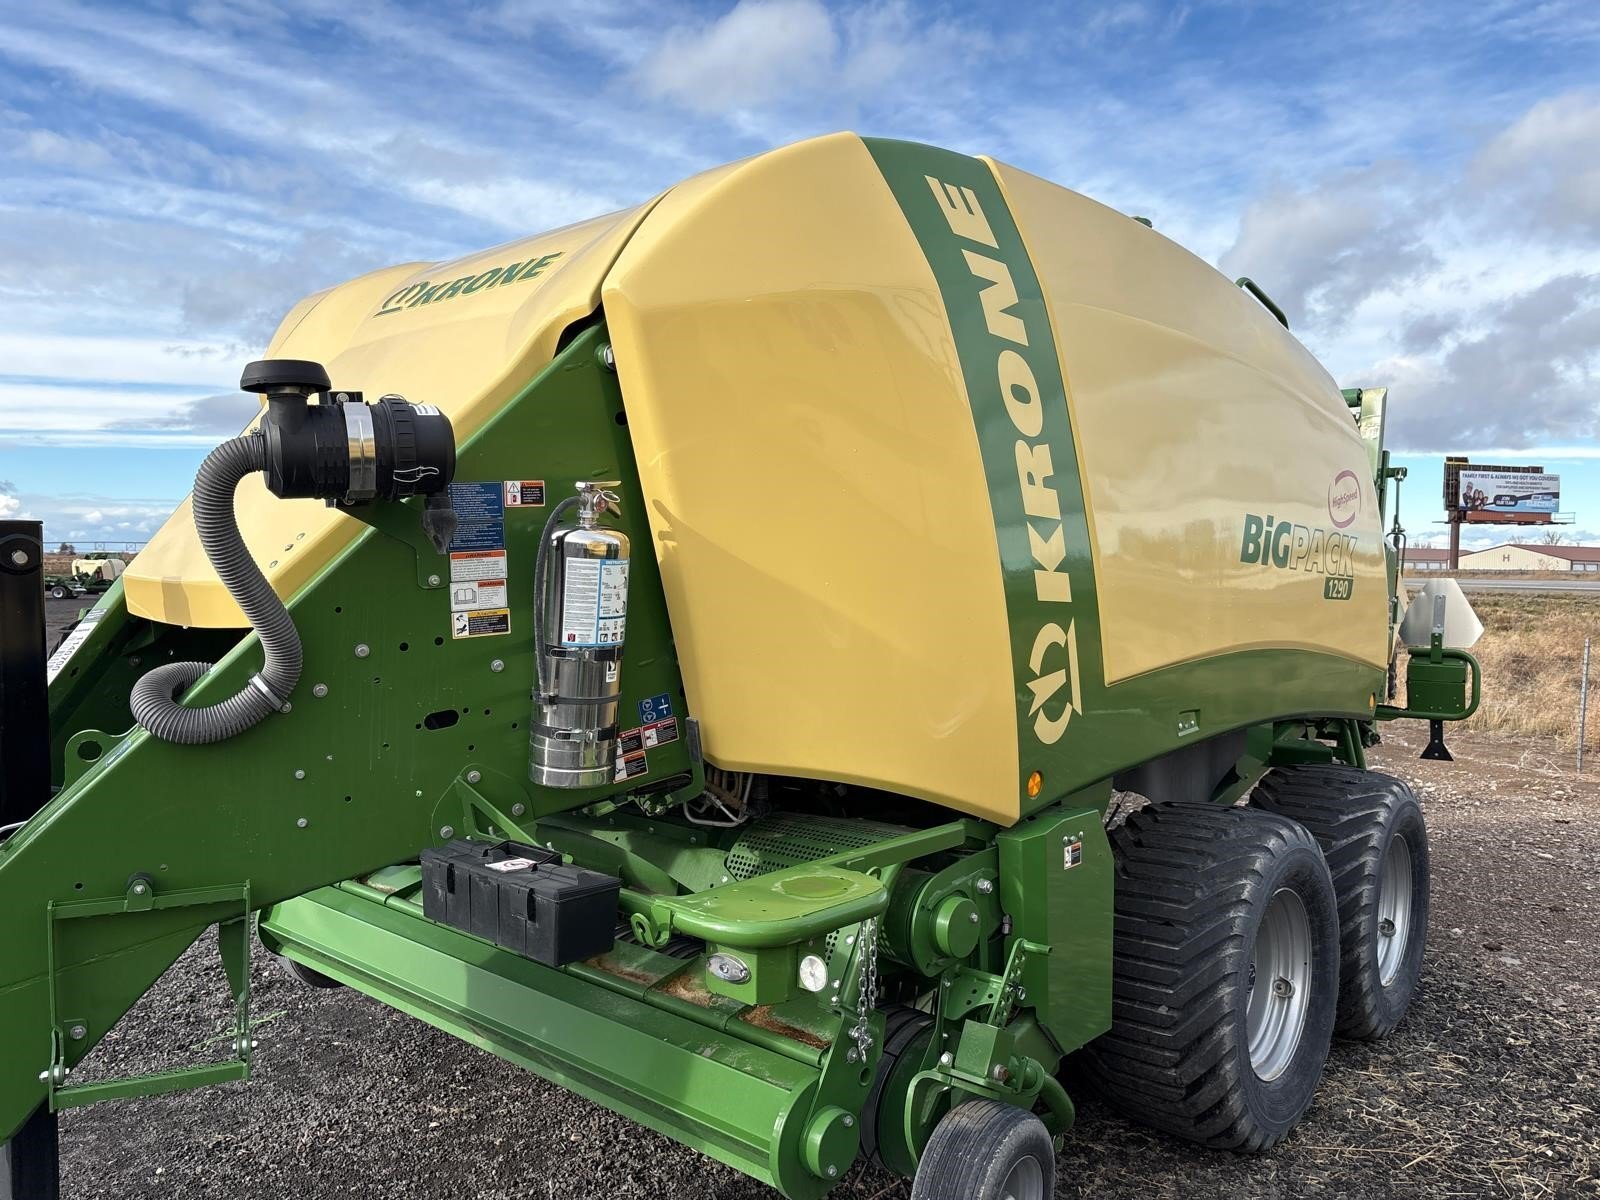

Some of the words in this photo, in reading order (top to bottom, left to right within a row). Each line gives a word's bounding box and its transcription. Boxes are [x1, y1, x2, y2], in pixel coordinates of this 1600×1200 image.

[407, 252, 565, 308] KRONE
[924, 174, 1072, 603] KRONE
[1328, 579, 1349, 598] 1290
